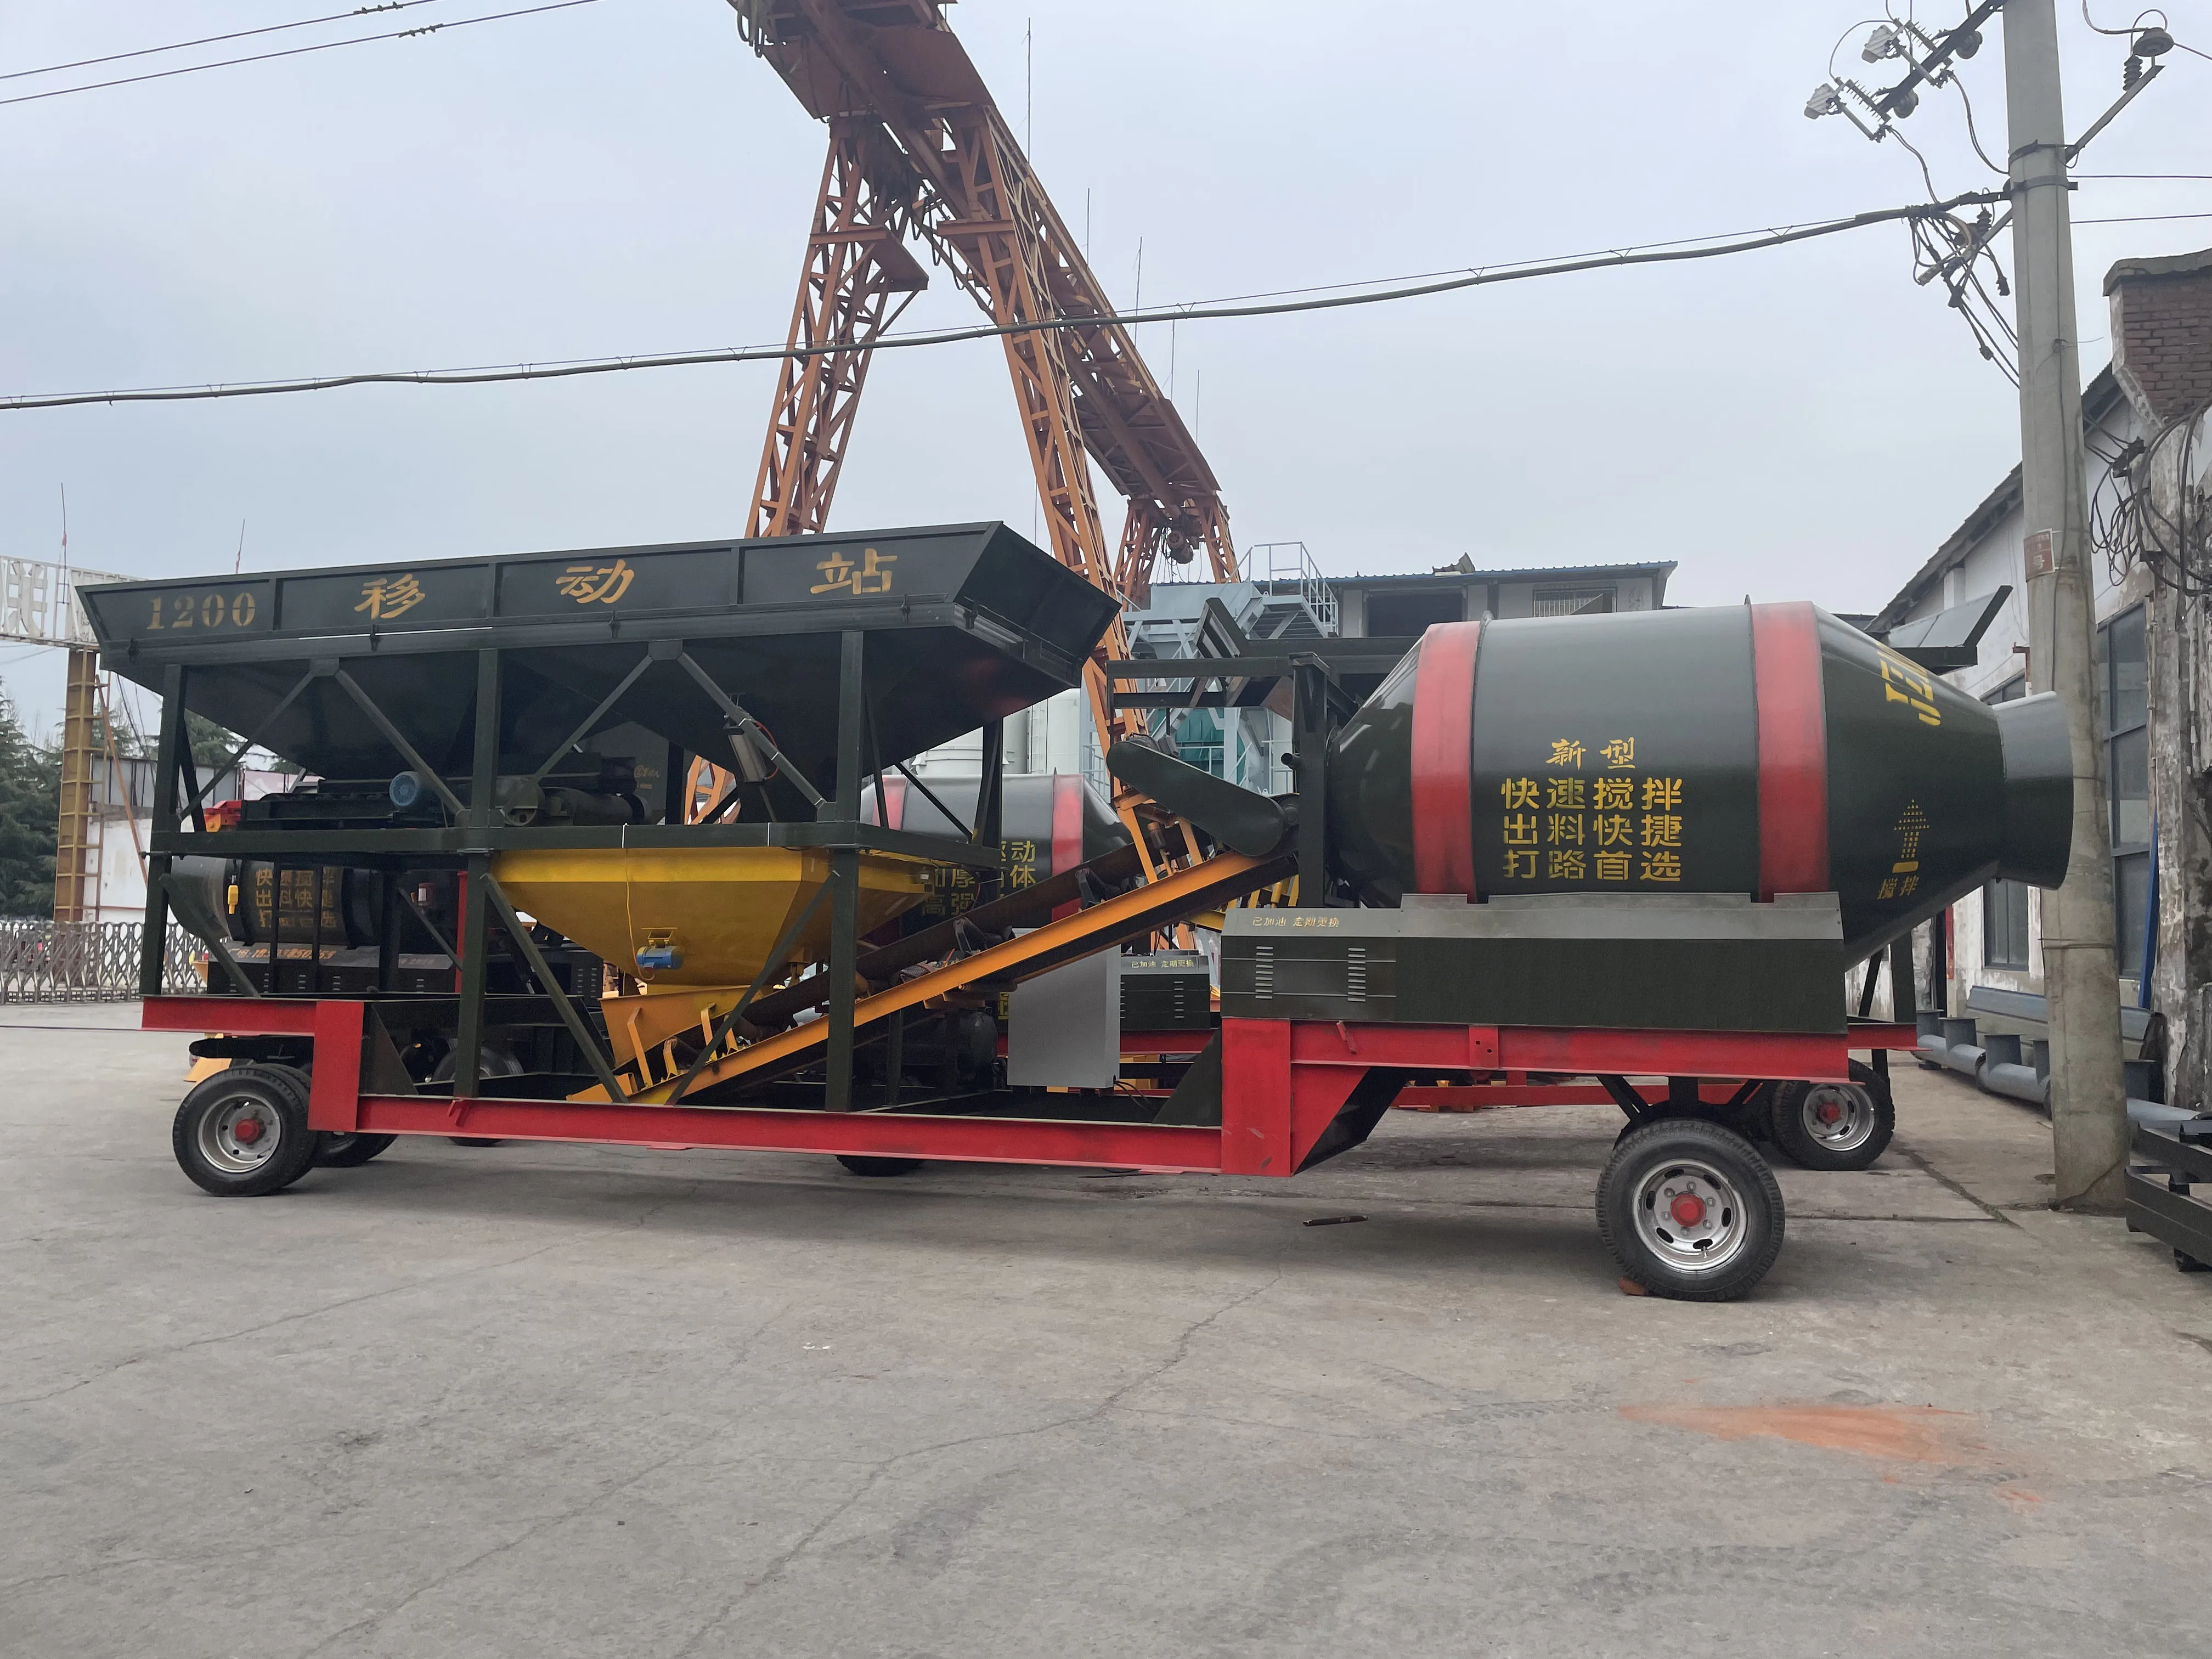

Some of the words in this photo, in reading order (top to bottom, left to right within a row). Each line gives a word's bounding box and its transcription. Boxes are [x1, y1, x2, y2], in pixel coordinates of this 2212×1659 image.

[146, 592, 257, 630] 1200
[1545, 736, 1636, 770] 新型
[1500, 776, 1684, 812] 快速搅拌
[1502, 812, 1683, 848] 出料快捷
[1503, 849, 1682, 883] 打路首选
